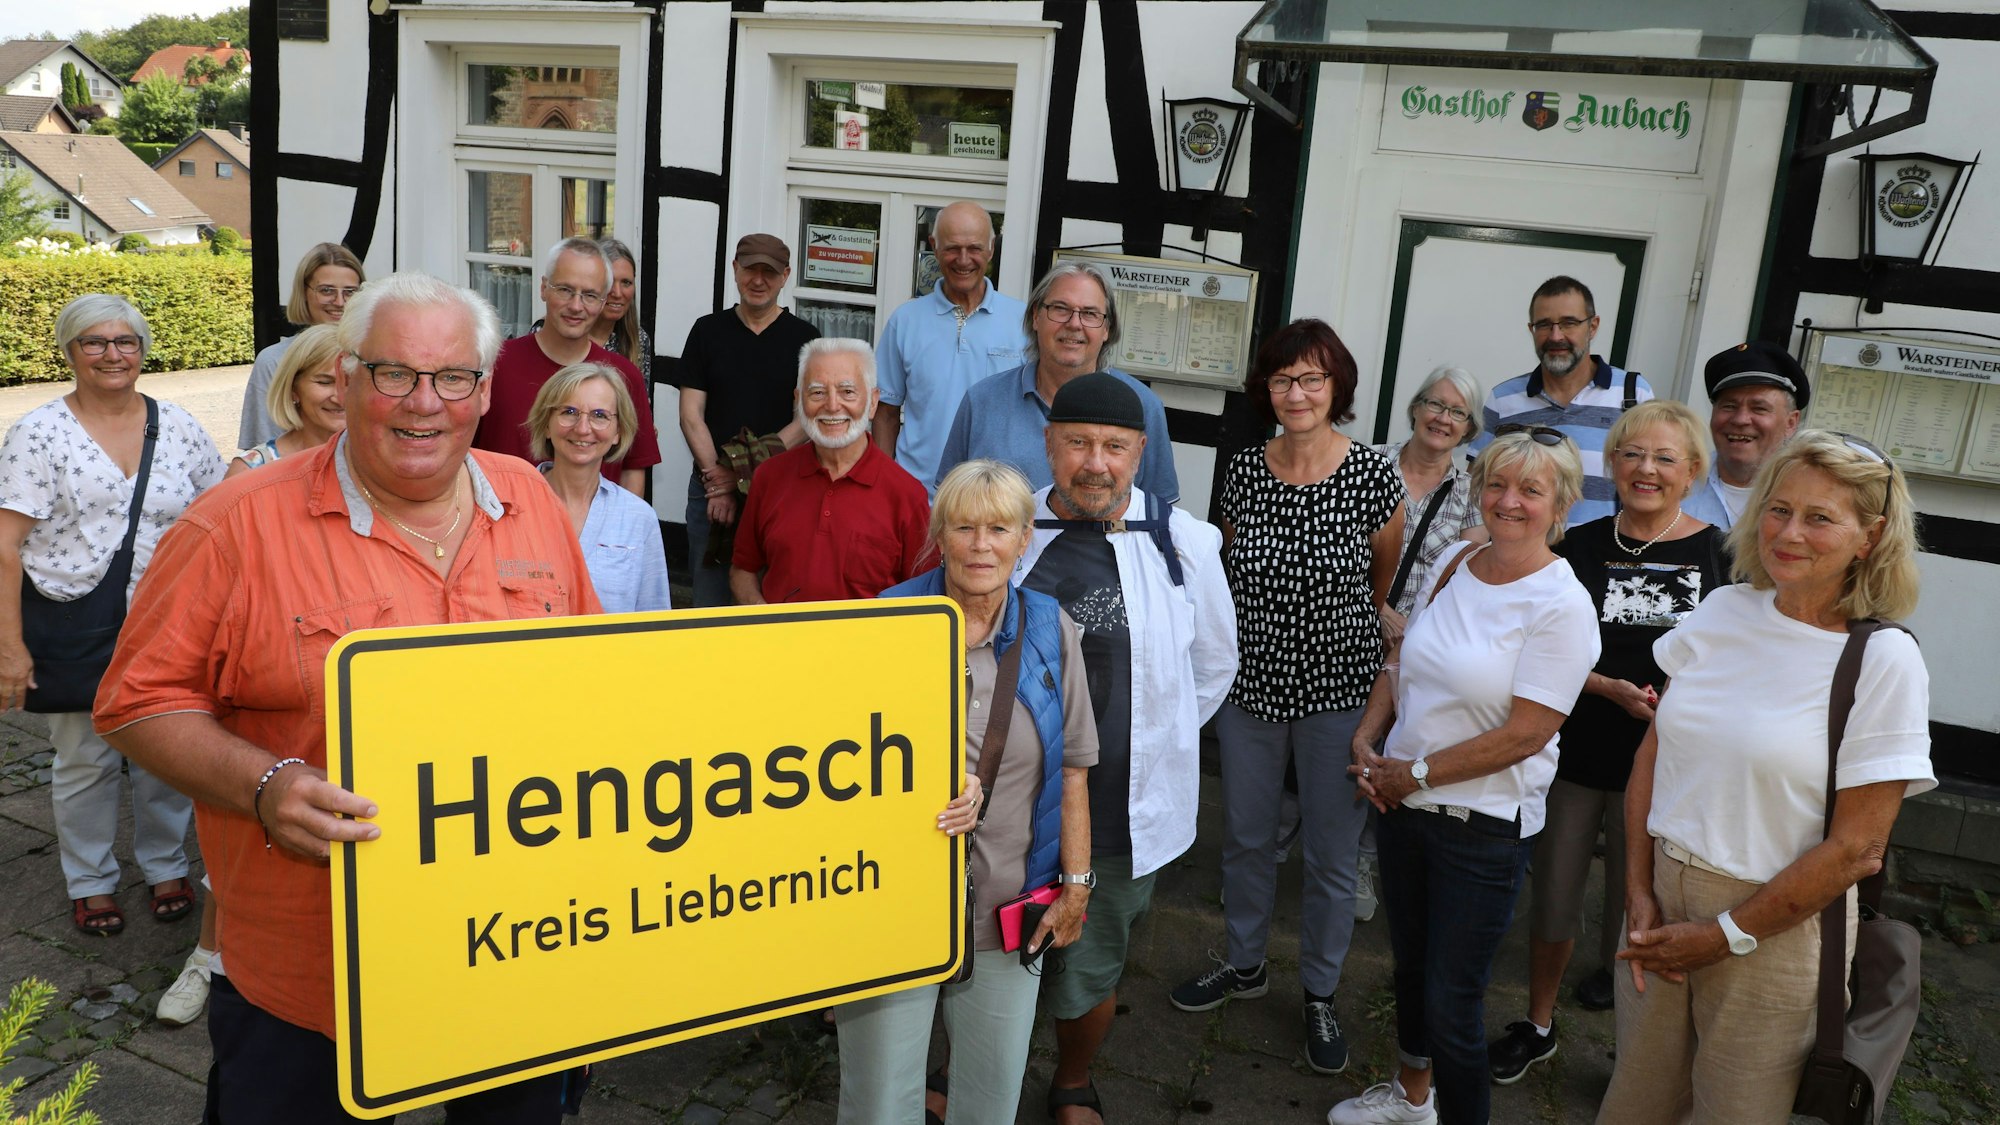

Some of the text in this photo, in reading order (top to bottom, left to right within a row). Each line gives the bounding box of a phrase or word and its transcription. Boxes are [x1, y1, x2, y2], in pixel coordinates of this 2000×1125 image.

[1402, 85, 1691, 139] Gasthof Aubach
[954, 133, 996, 146] heute
[1217, 123, 1227, 147] BIEREN
[953, 146, 995, 155] geschlossen
[1192, 156, 1213, 164] UNTER
[1213, 148, 1224, 159] DEN
[1880, 179, 1895, 195] EINE
[1893, 219, 1919, 228] UNTER
[1919, 209, 1934, 223] DEN
[1929, 182, 1940, 209] BIEREN
[838, 234, 872, 245] Gaststätte
[827, 251, 863, 261] verpachten
[1110, 266, 1190, 287] WARSTEINER
[1897, 347, 2000, 373] WARSTEINER
[1903, 364, 1933, 374] Botschaft
[1954, 370, 1992, 381] Gastlichkeit
[417, 712, 914, 865] Hengasch
[466, 850, 881, 968] Kreis Liebernich
